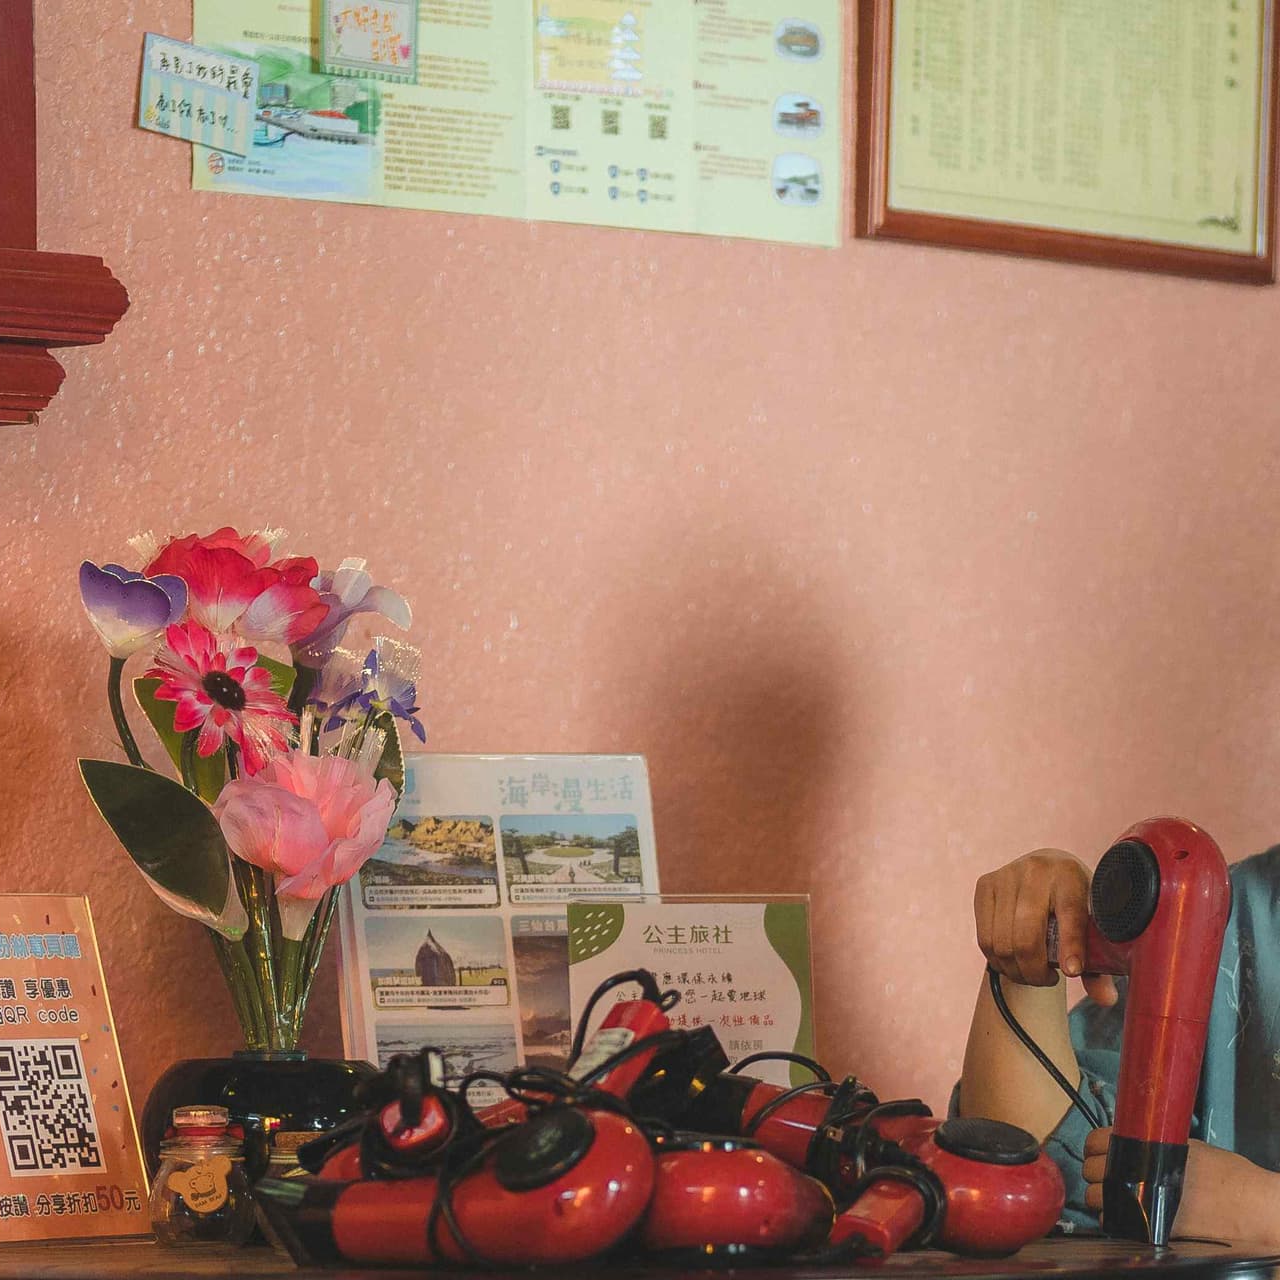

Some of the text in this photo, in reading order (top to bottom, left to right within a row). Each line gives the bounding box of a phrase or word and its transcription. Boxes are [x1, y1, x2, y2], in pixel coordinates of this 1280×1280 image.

[642, 925, 734, 945] 公主旅社
[650, 971, 733, 985] 應環保永續
[23, 978, 73, 999] 享優惠
[38, 1006, 79, 1023] code
[36, 1185, 141, 1216] 分享折扣50元
